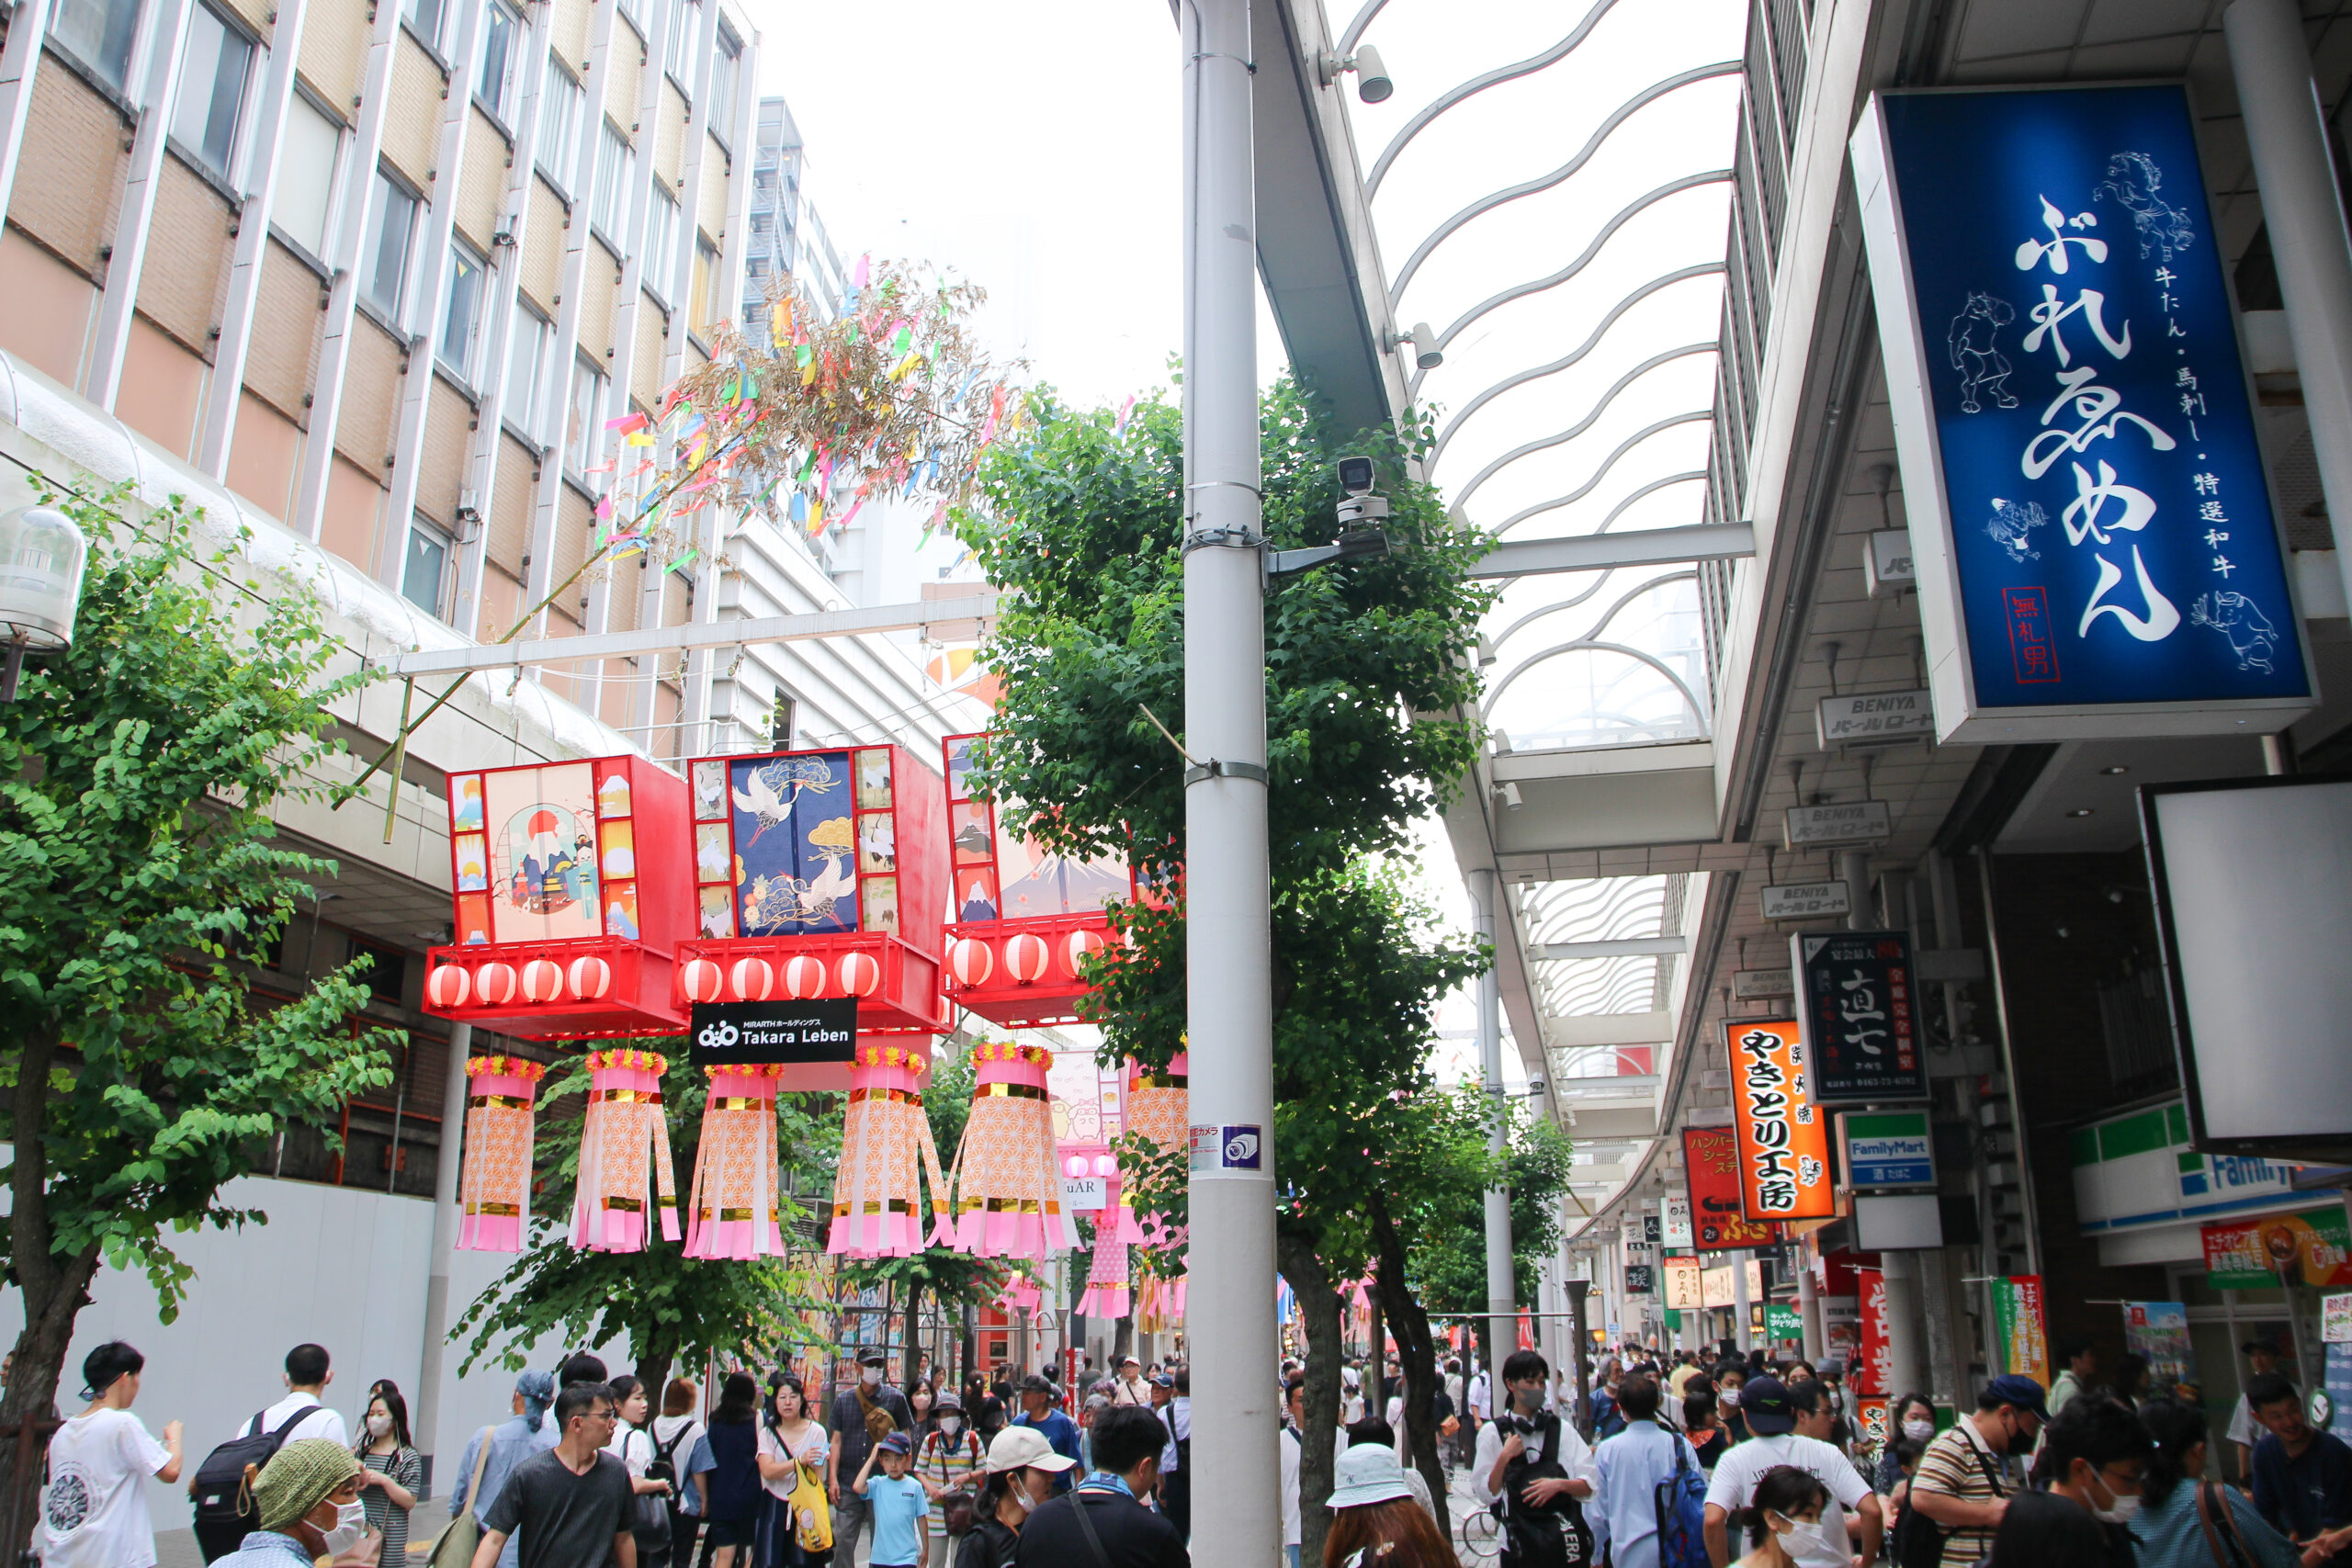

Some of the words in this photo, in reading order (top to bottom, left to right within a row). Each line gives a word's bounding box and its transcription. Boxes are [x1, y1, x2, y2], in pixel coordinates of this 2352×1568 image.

[1851, 695, 1916, 714] BENIYA
[1812, 807, 1865, 822] BENIYA
[1783, 886, 1829, 899] BENIYA
[742, 1030, 795, 1045] Takara
[802, 1029, 849, 1043] Leben
[1741, 1031, 1796, 1211] やきとり工房
[1852, 1141, 1926, 1156] FamilyMart
[1064, 1180, 1095, 1193] uAR
[1704, 1229, 1717, 1239] 2F
[2207, 1229, 2262, 1250] エチオピア産
[2026, 1282, 2042, 1361] エチオピア産
[1564, 1533, 1581, 1564] ERA
